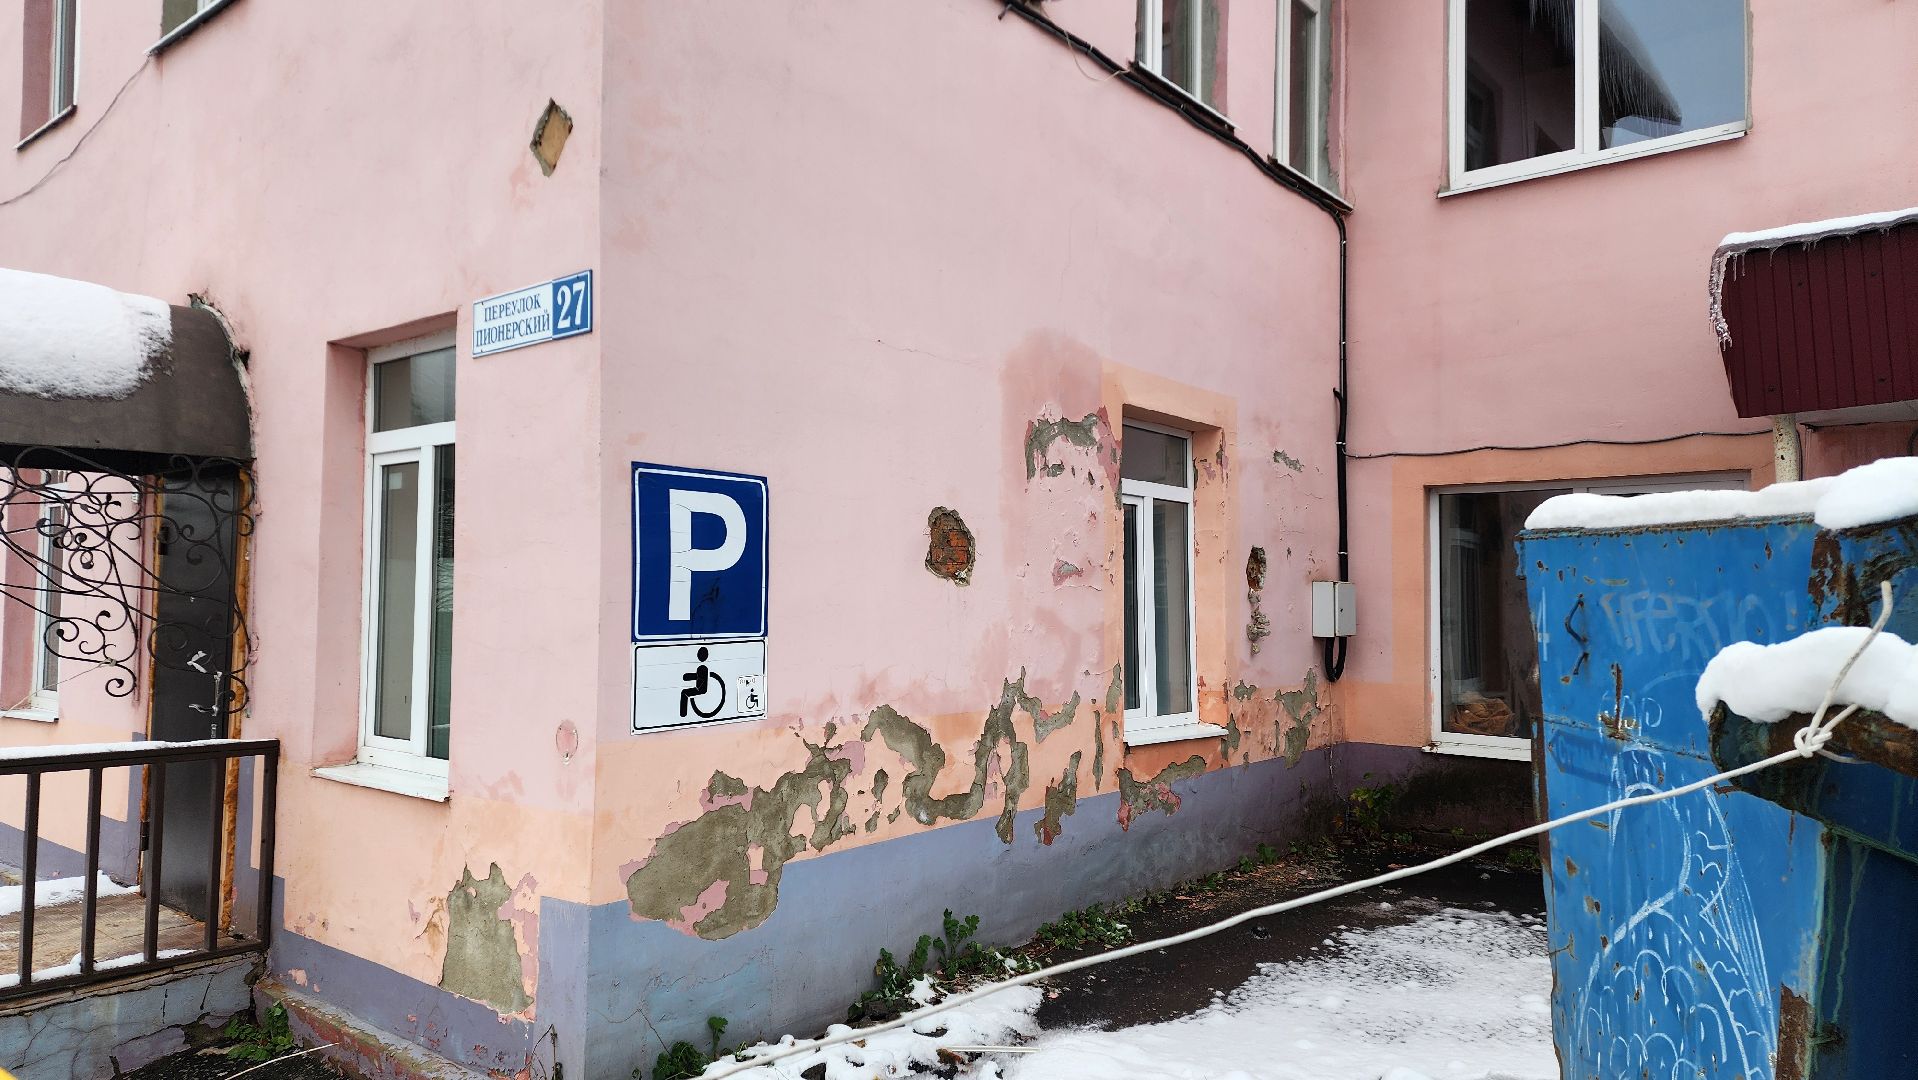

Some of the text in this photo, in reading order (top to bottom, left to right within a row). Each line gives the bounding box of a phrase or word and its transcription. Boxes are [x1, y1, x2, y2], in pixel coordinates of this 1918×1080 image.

[484, 293, 541, 322] ПЕРЕУЛОК
[556, 281, 586, 329] 27
[475, 310, 550, 347] ПИОНЕРСКИЙ
[668, 488, 747, 621] P
